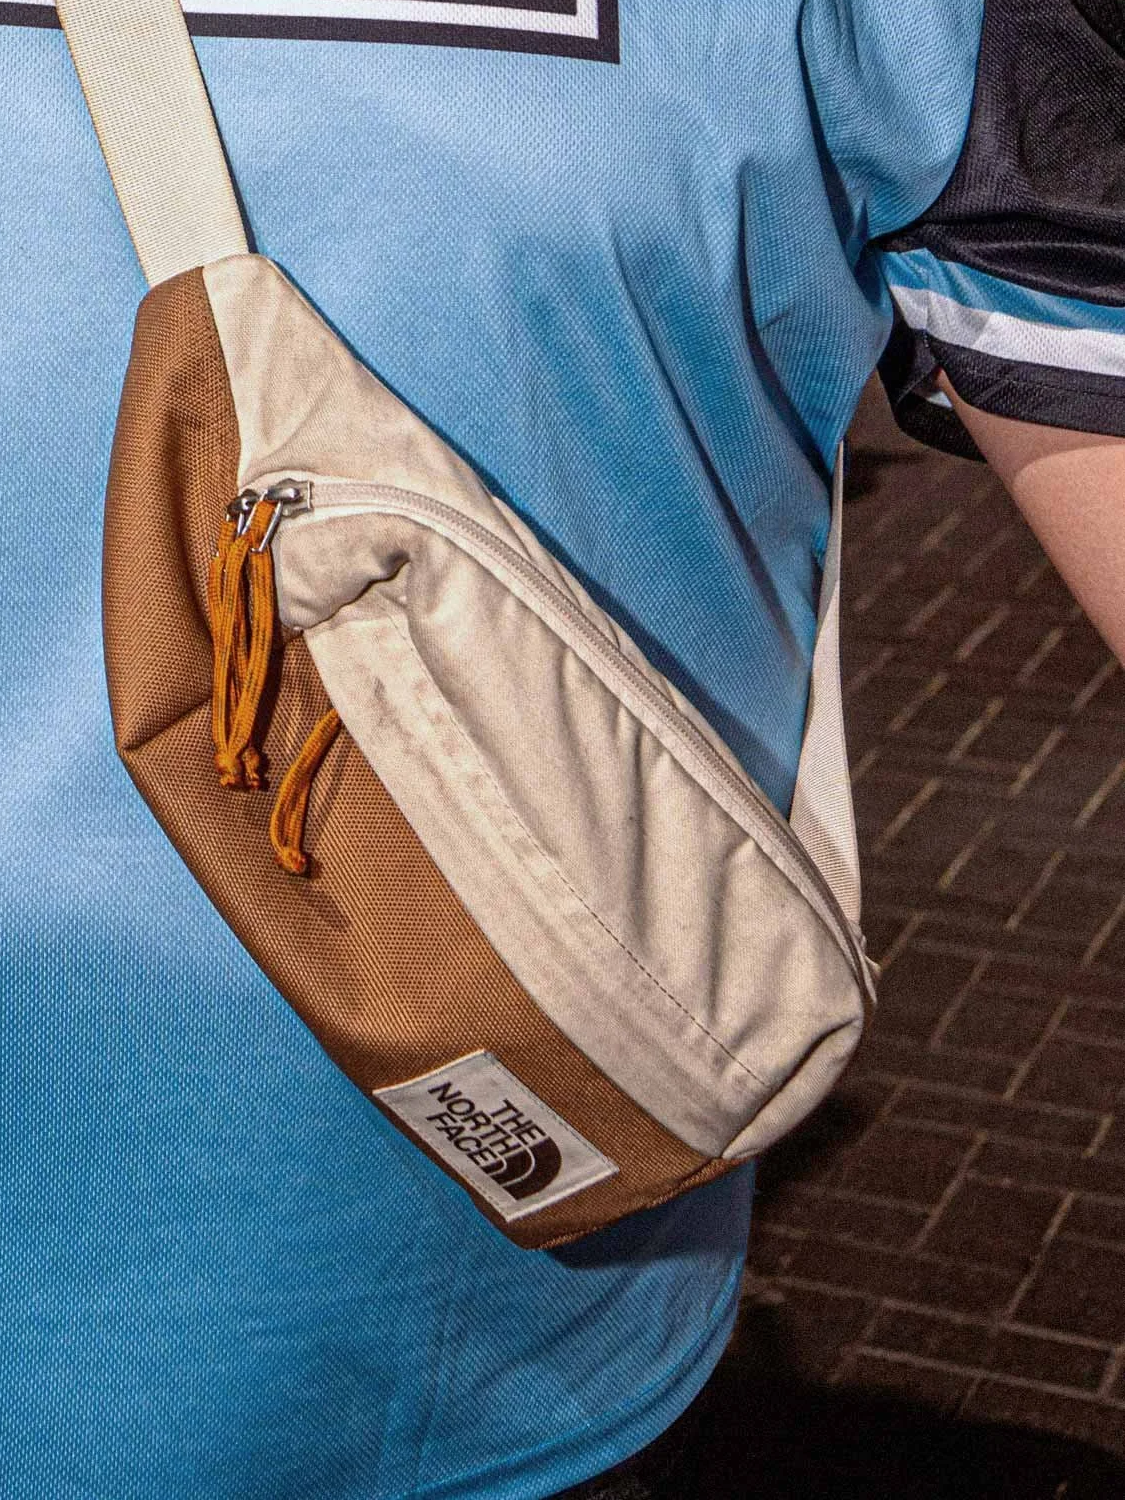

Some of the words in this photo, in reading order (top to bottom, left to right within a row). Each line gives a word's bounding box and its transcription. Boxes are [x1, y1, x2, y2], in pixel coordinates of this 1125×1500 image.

[426, 1112, 497, 1167] FACE
[427, 1082, 522, 1156] NORTH
[490, 1099, 546, 1147] THE
